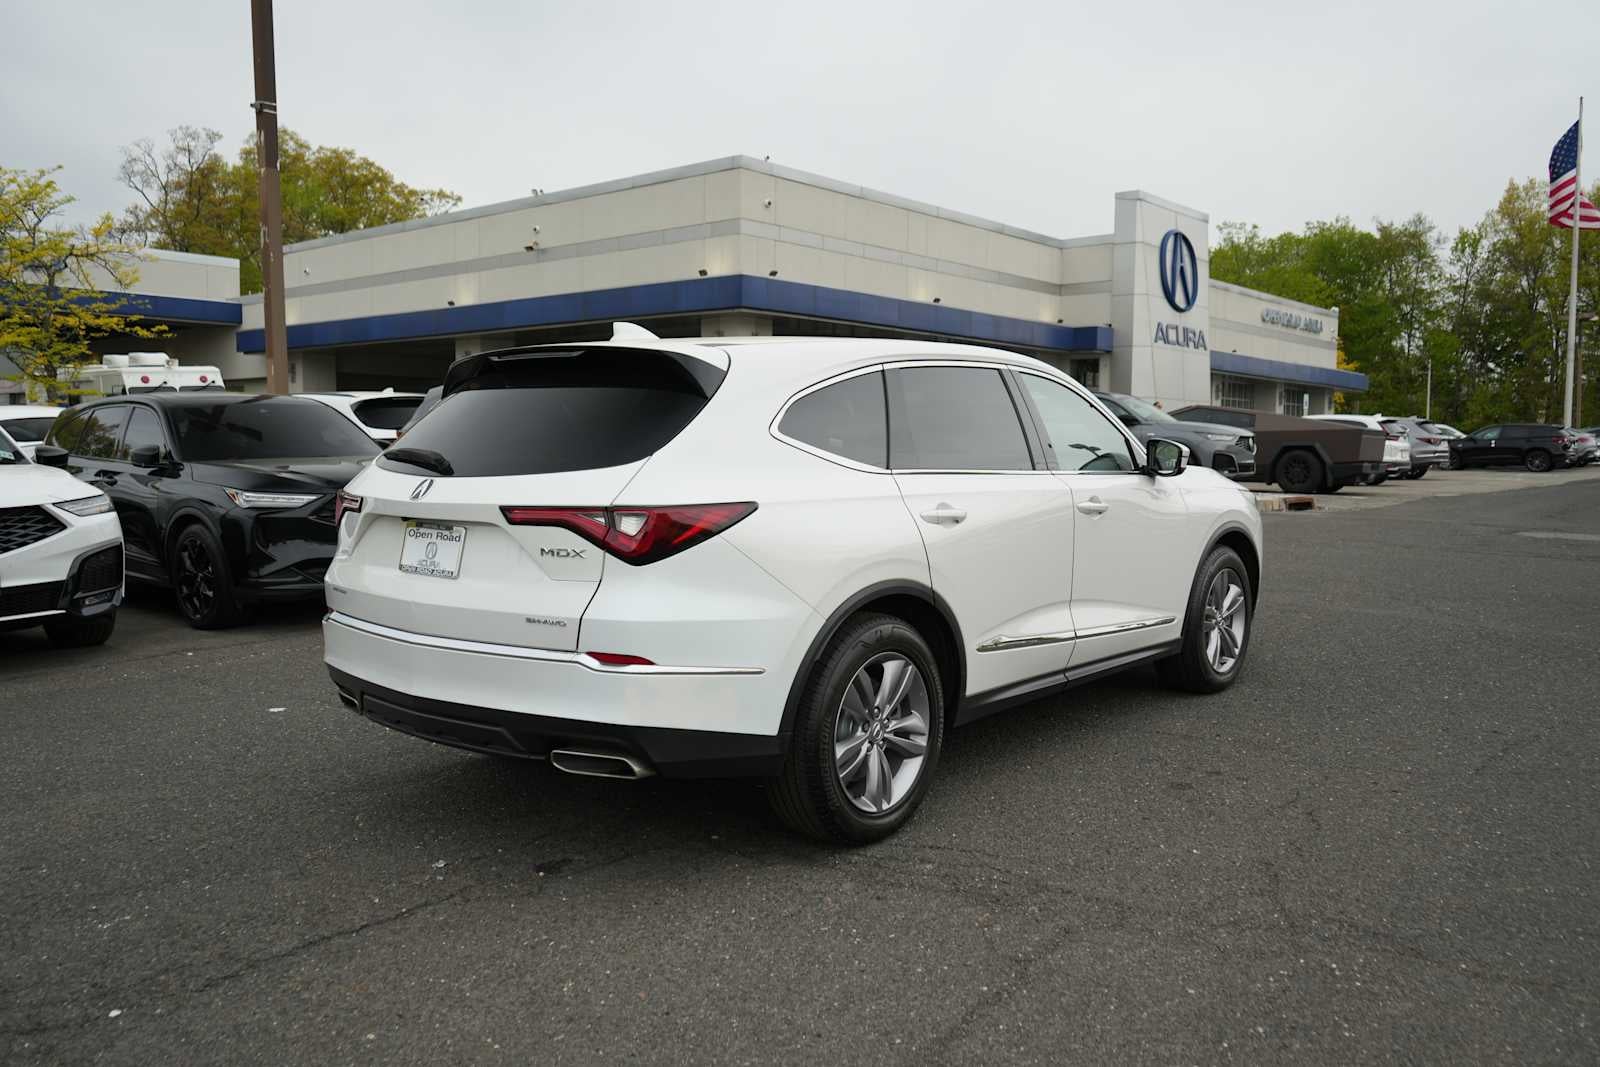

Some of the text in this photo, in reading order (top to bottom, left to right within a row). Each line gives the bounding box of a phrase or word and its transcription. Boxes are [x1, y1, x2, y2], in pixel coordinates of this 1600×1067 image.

[1154, 321, 1207, 351] ACURA
[408, 528, 461, 543] Open Road
[540, 547, 587, 559] MDX
